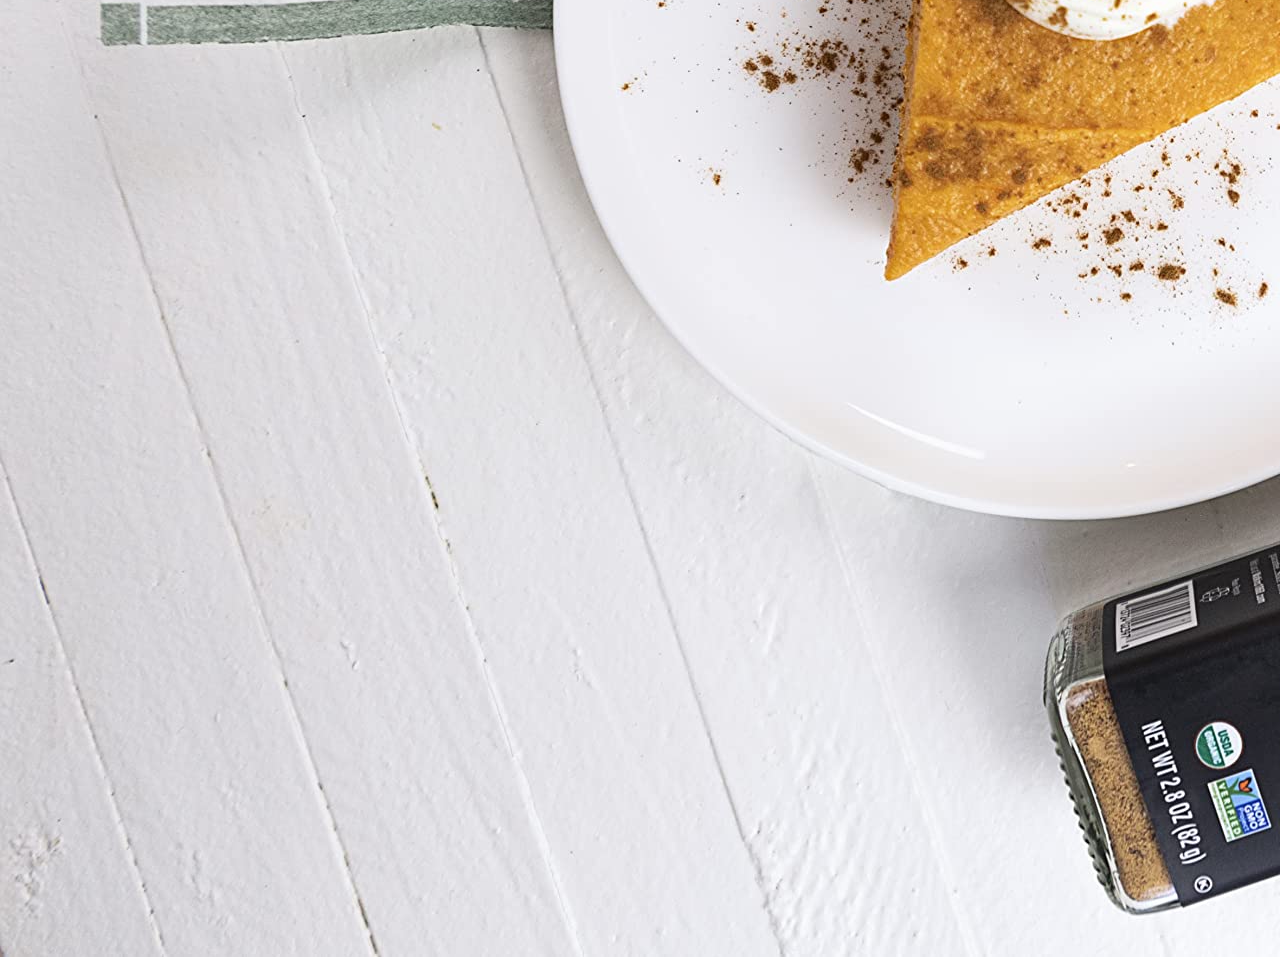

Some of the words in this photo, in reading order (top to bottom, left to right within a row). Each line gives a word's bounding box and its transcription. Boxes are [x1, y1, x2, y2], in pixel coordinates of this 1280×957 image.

[1140, 720, 1168, 751] NET
[1202, 729, 1222, 765] ORGANIC
[1217, 729, 1234, 757] USDA
[1150, 749, 1177, 778] WT
[1158, 775, 1186, 803] 2.8
[1166, 800, 1193, 824] OZ
[1217, 782, 1240, 836] VERIFIED
[1242, 804, 1257, 830] GMO
[1251, 801, 1266, 826] NON
[1170, 823, 1201, 849] (82
[1177, 846, 1207, 865] g)
